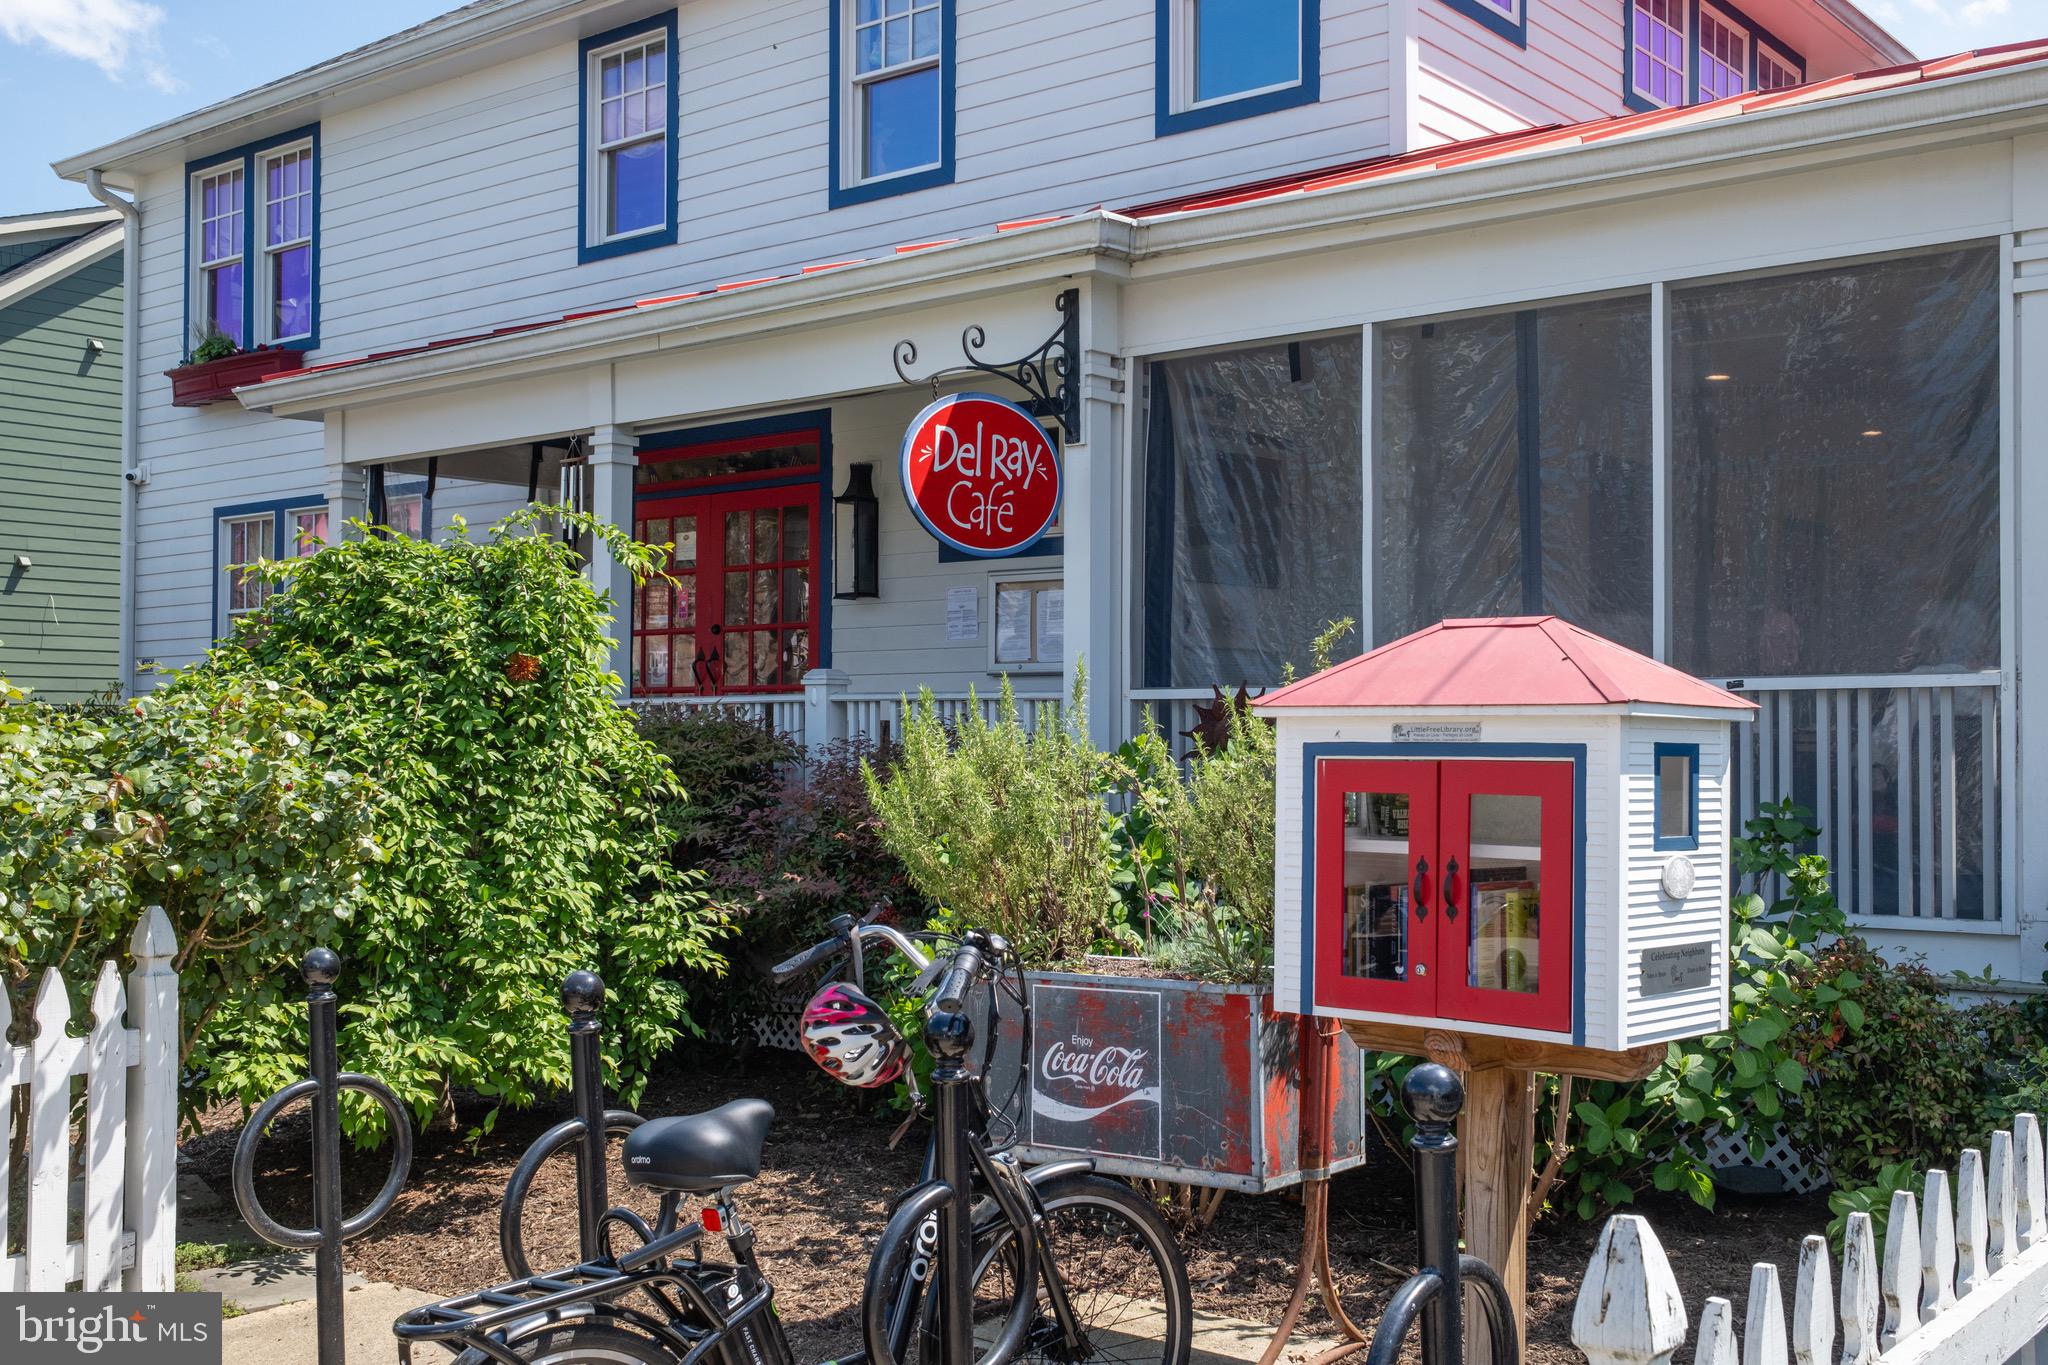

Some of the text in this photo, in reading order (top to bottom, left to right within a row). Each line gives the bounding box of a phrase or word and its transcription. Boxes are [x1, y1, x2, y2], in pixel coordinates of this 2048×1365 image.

[933, 421, 1042, 490] Del Ray
[947, 480, 1014, 536] Café
[1041, 1041, 1148, 1089] Coca-Cola
[1071, 1034, 1094, 1048] Enjoy
[742, 1326, 753, 1344] FAST
